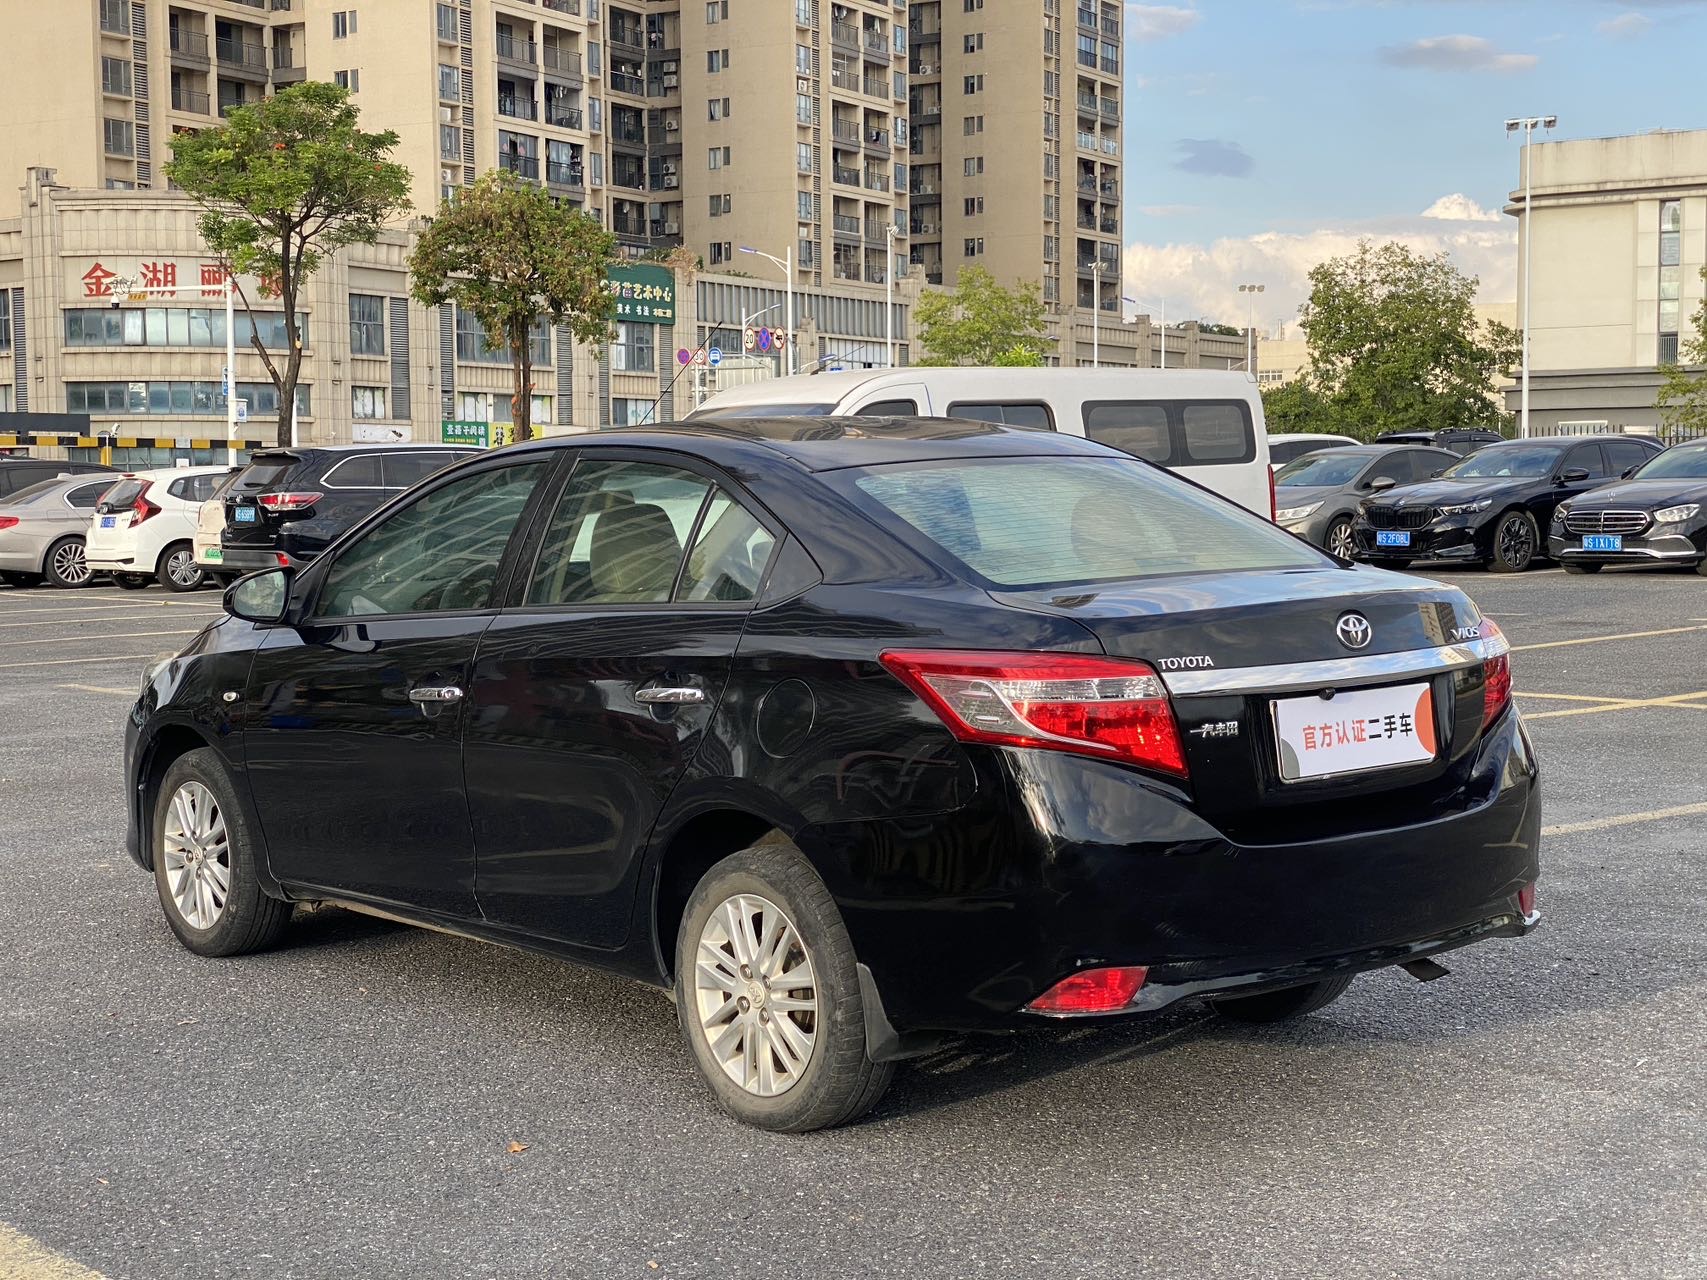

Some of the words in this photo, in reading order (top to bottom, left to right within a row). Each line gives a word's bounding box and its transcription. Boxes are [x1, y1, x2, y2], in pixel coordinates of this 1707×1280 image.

[745, 333, 754, 344] 20
[1451, 627, 1480, 640] VIOS
[1158, 655, 1214, 670] TOYOTA
[1302, 712, 1413, 751] 官方认证二手车
